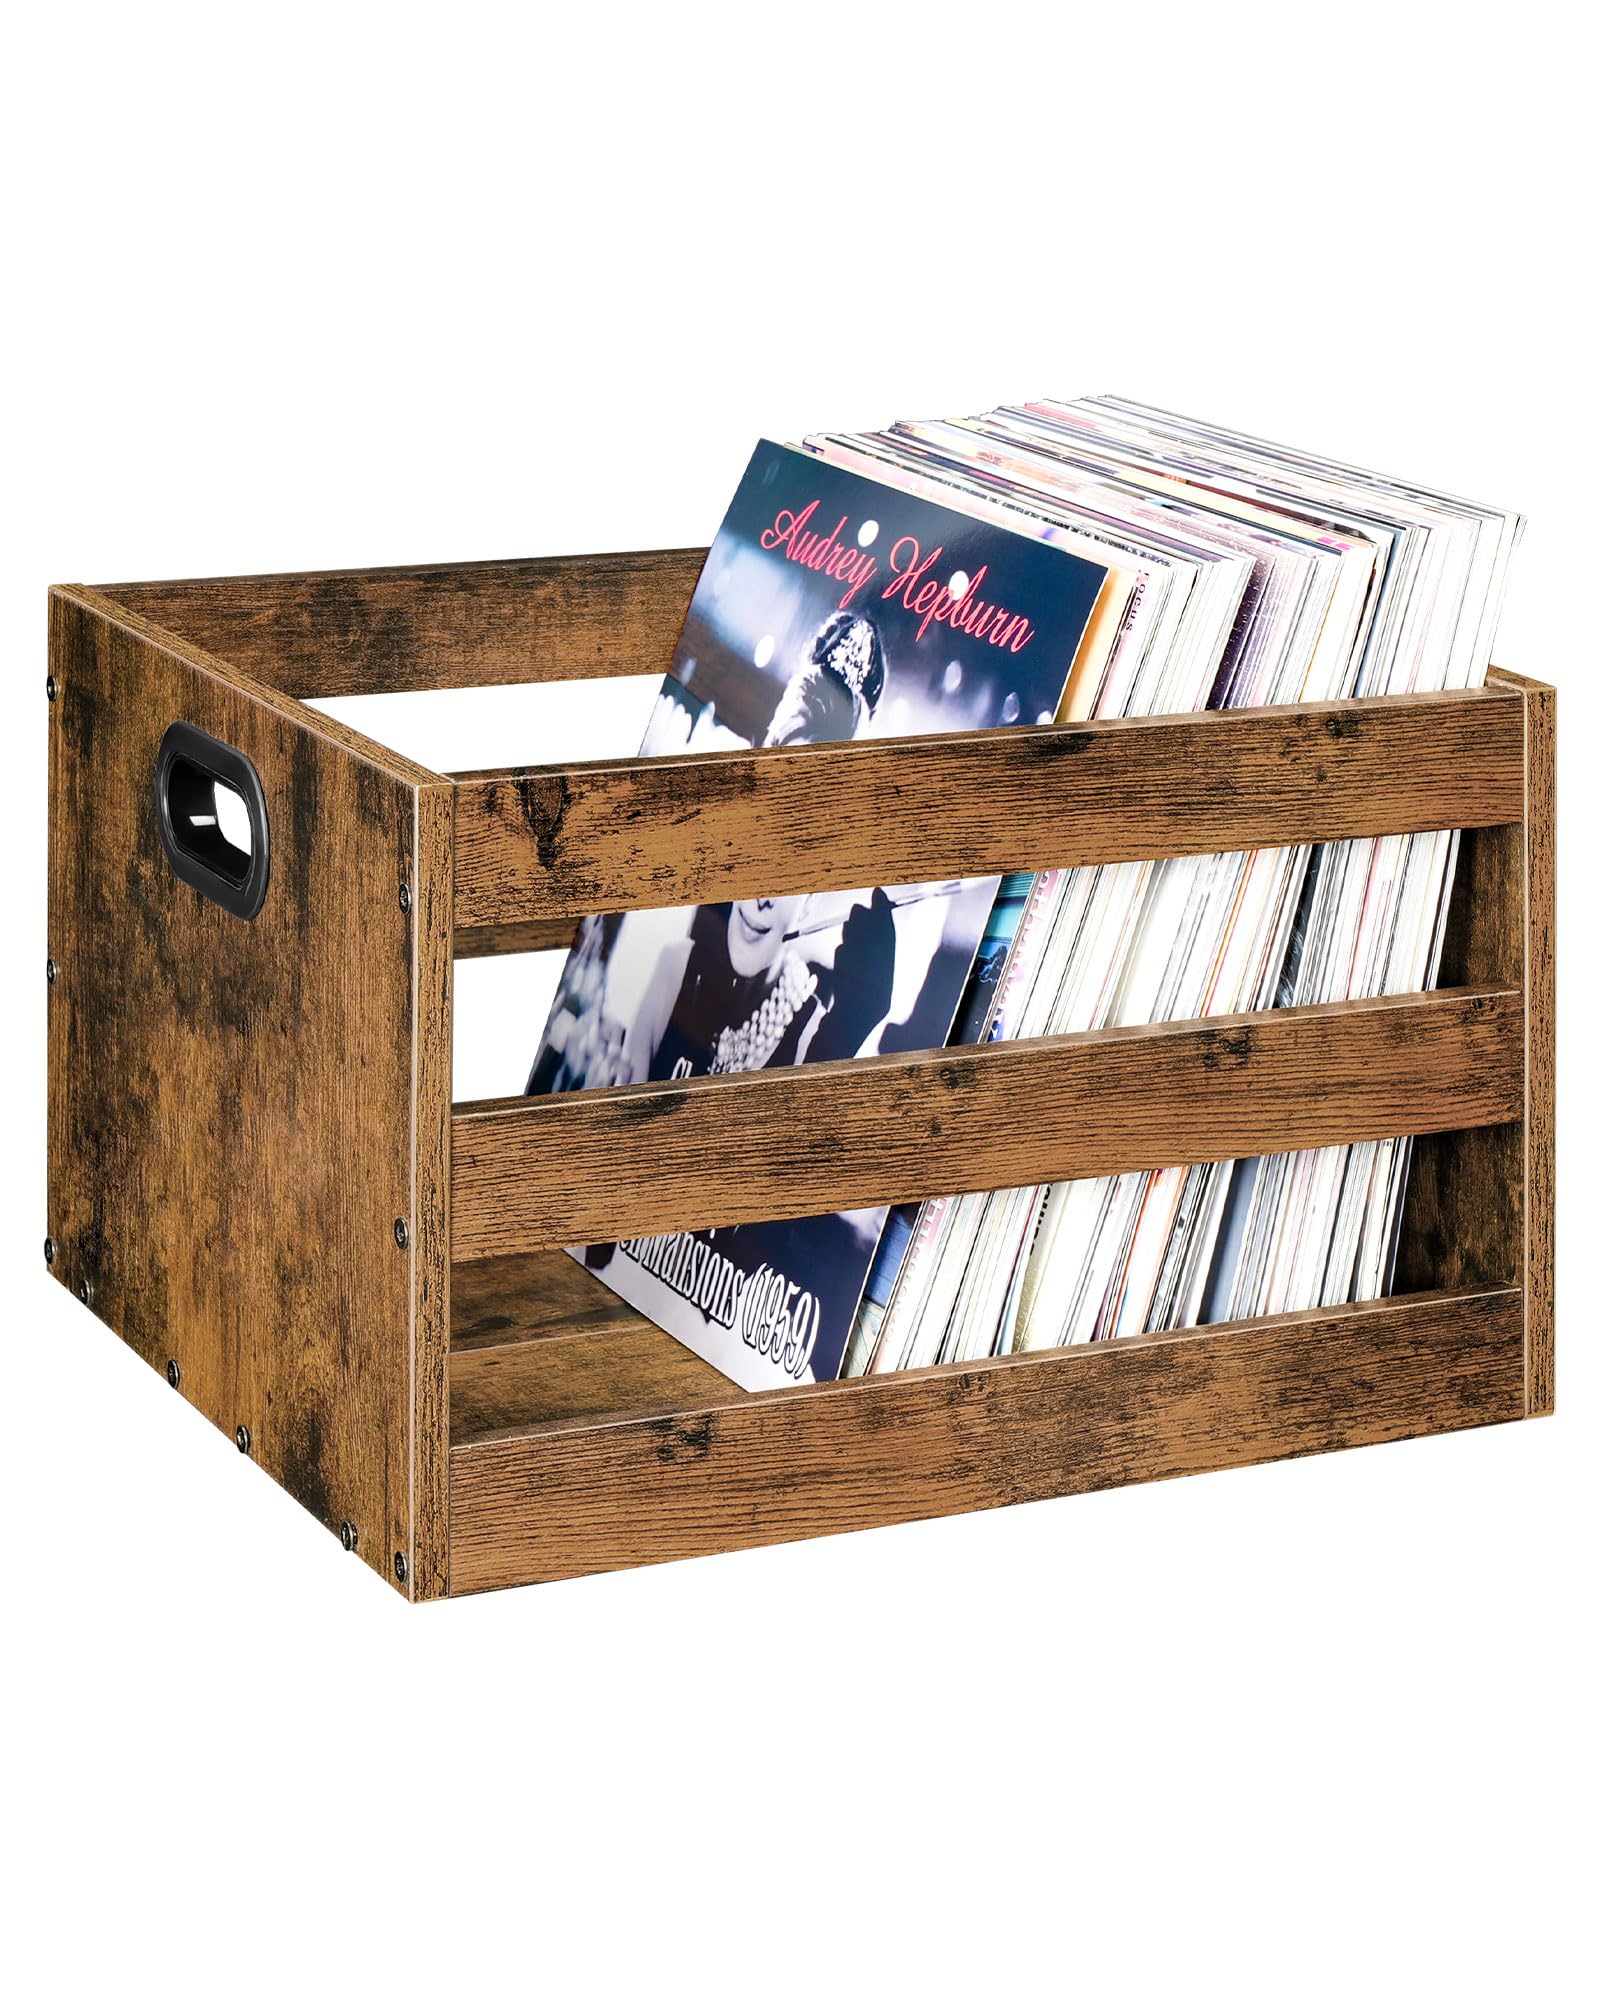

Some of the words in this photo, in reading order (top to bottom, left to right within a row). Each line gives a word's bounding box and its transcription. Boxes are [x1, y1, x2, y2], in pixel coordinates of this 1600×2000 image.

[760, 499, 878, 609] Audrey
[881, 536, 1036, 653] Hepburn
[740, 1262, 821, 1380] (1959)
